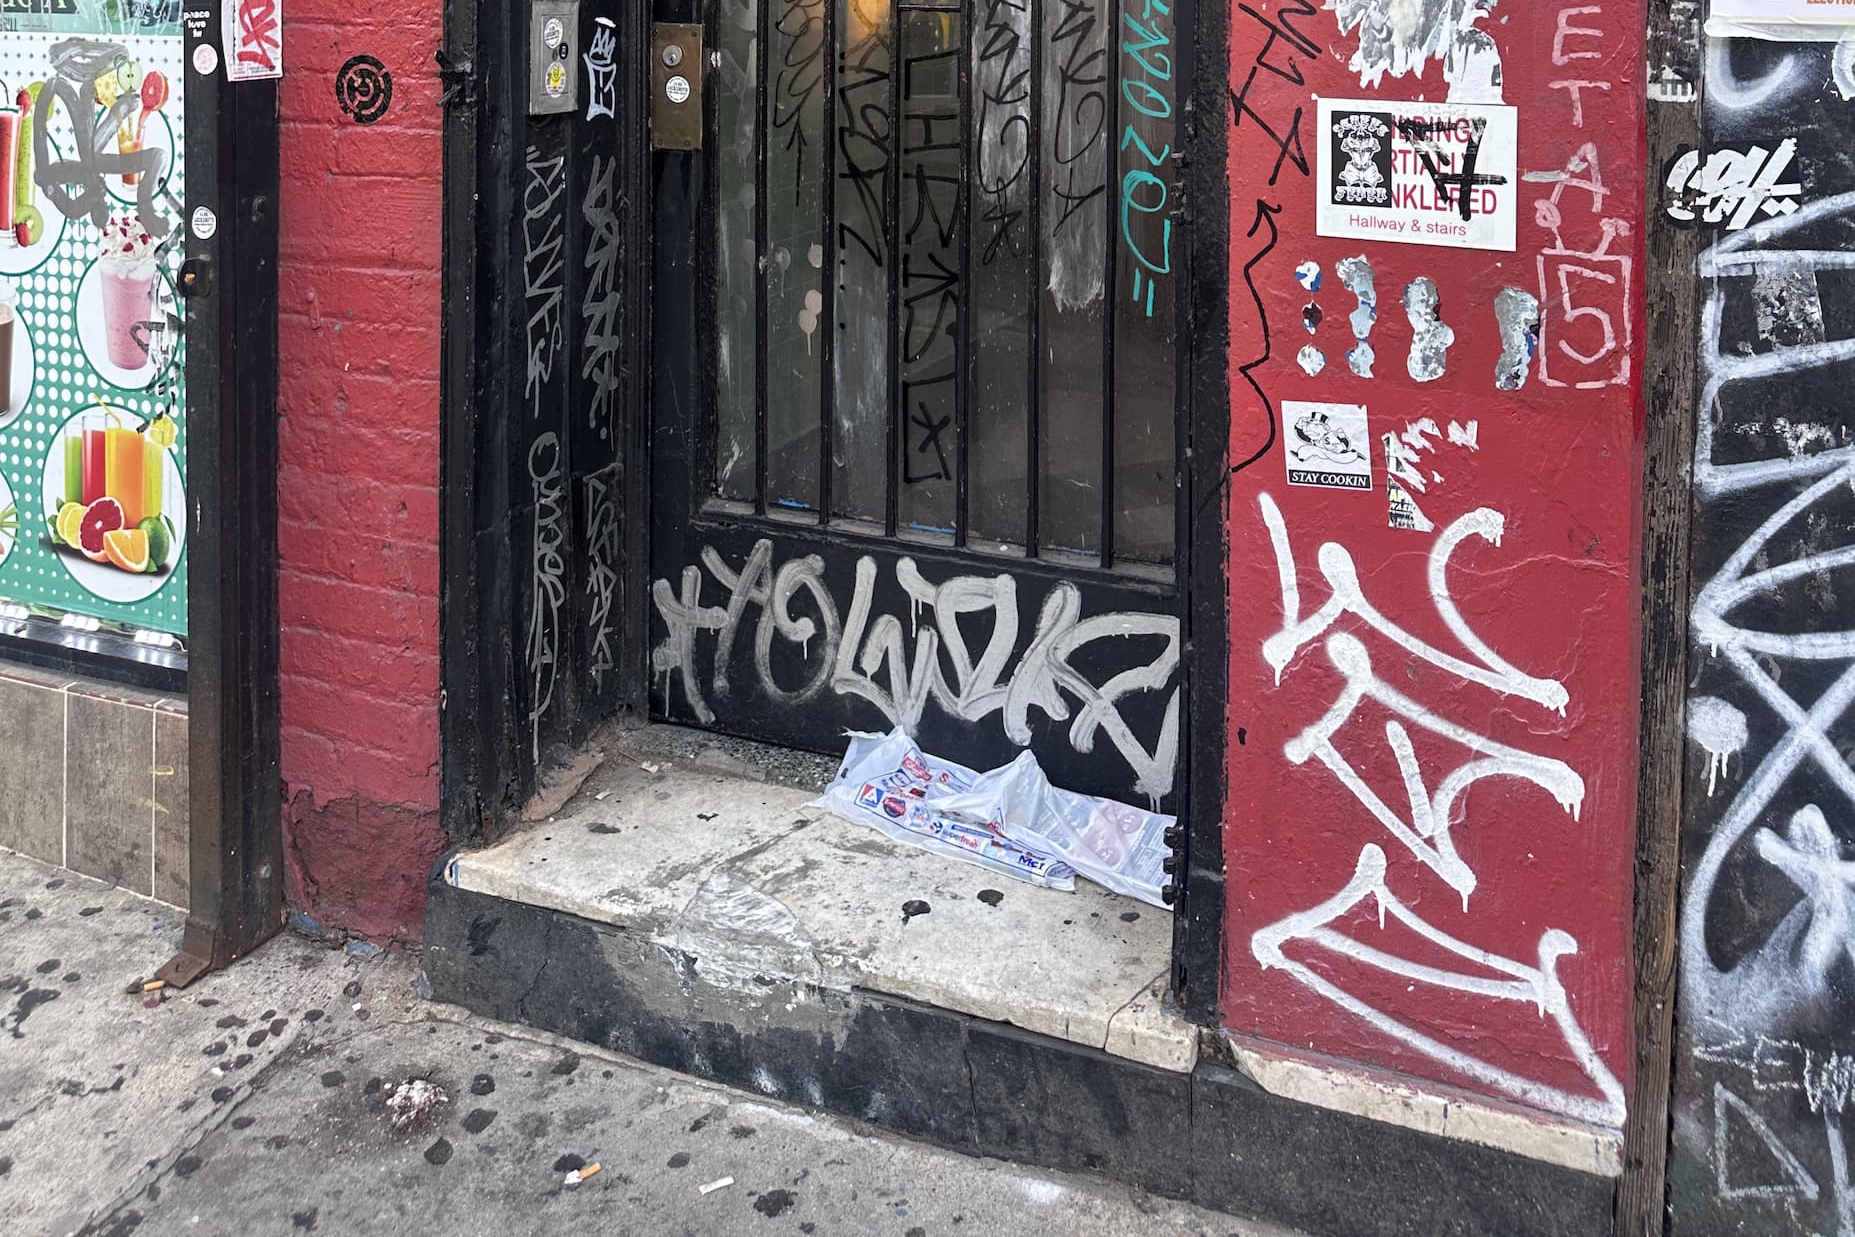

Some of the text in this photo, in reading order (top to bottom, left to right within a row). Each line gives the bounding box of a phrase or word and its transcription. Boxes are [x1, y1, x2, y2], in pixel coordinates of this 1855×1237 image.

[1349, 213, 1467, 236] Hallway & stairs
[1291, 470, 1367, 487] STAY COOKIN
